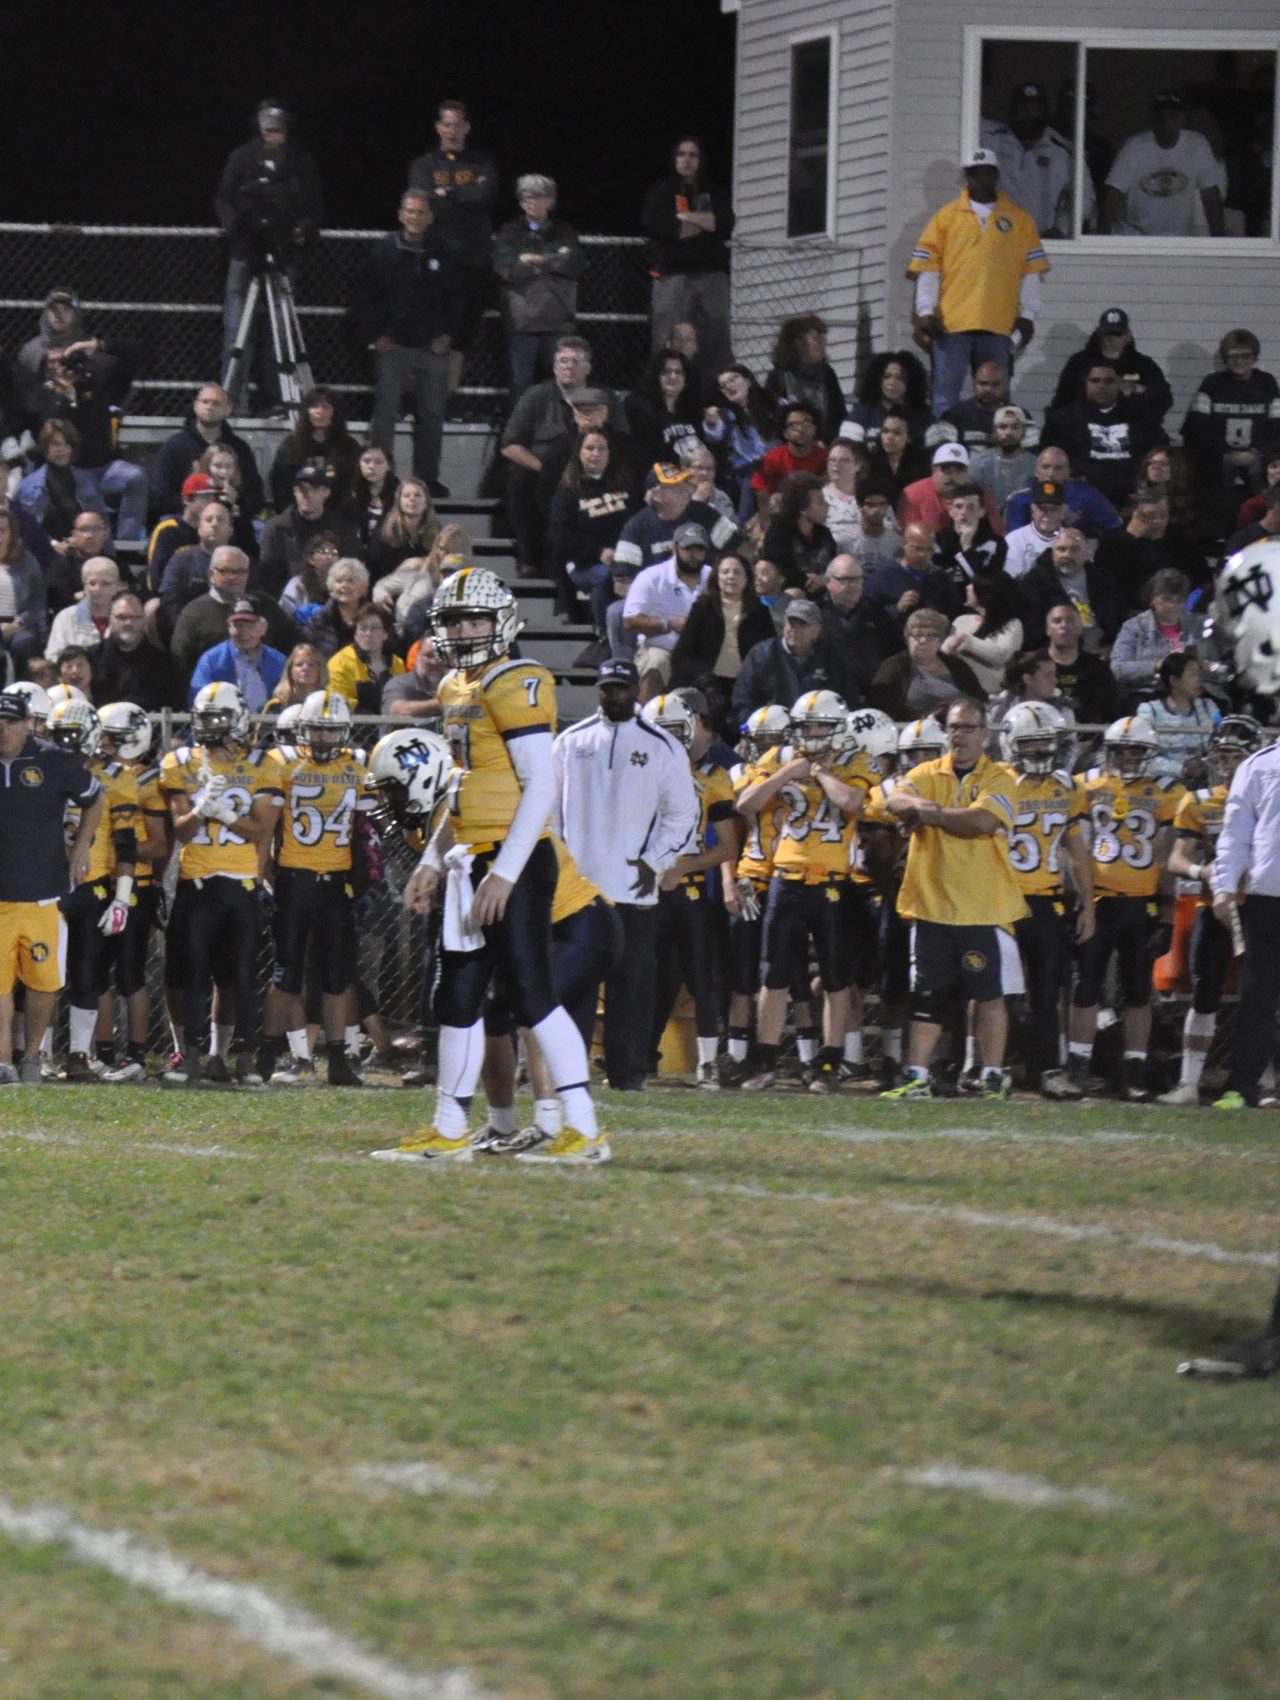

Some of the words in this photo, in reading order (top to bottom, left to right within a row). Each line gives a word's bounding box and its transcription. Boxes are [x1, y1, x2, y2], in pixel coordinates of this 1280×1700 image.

[522, 676, 540, 707] 7
[290, 784, 357, 847] 54
[1007, 811, 1068, 873] 57
[1091, 803, 1156, 870] 83
